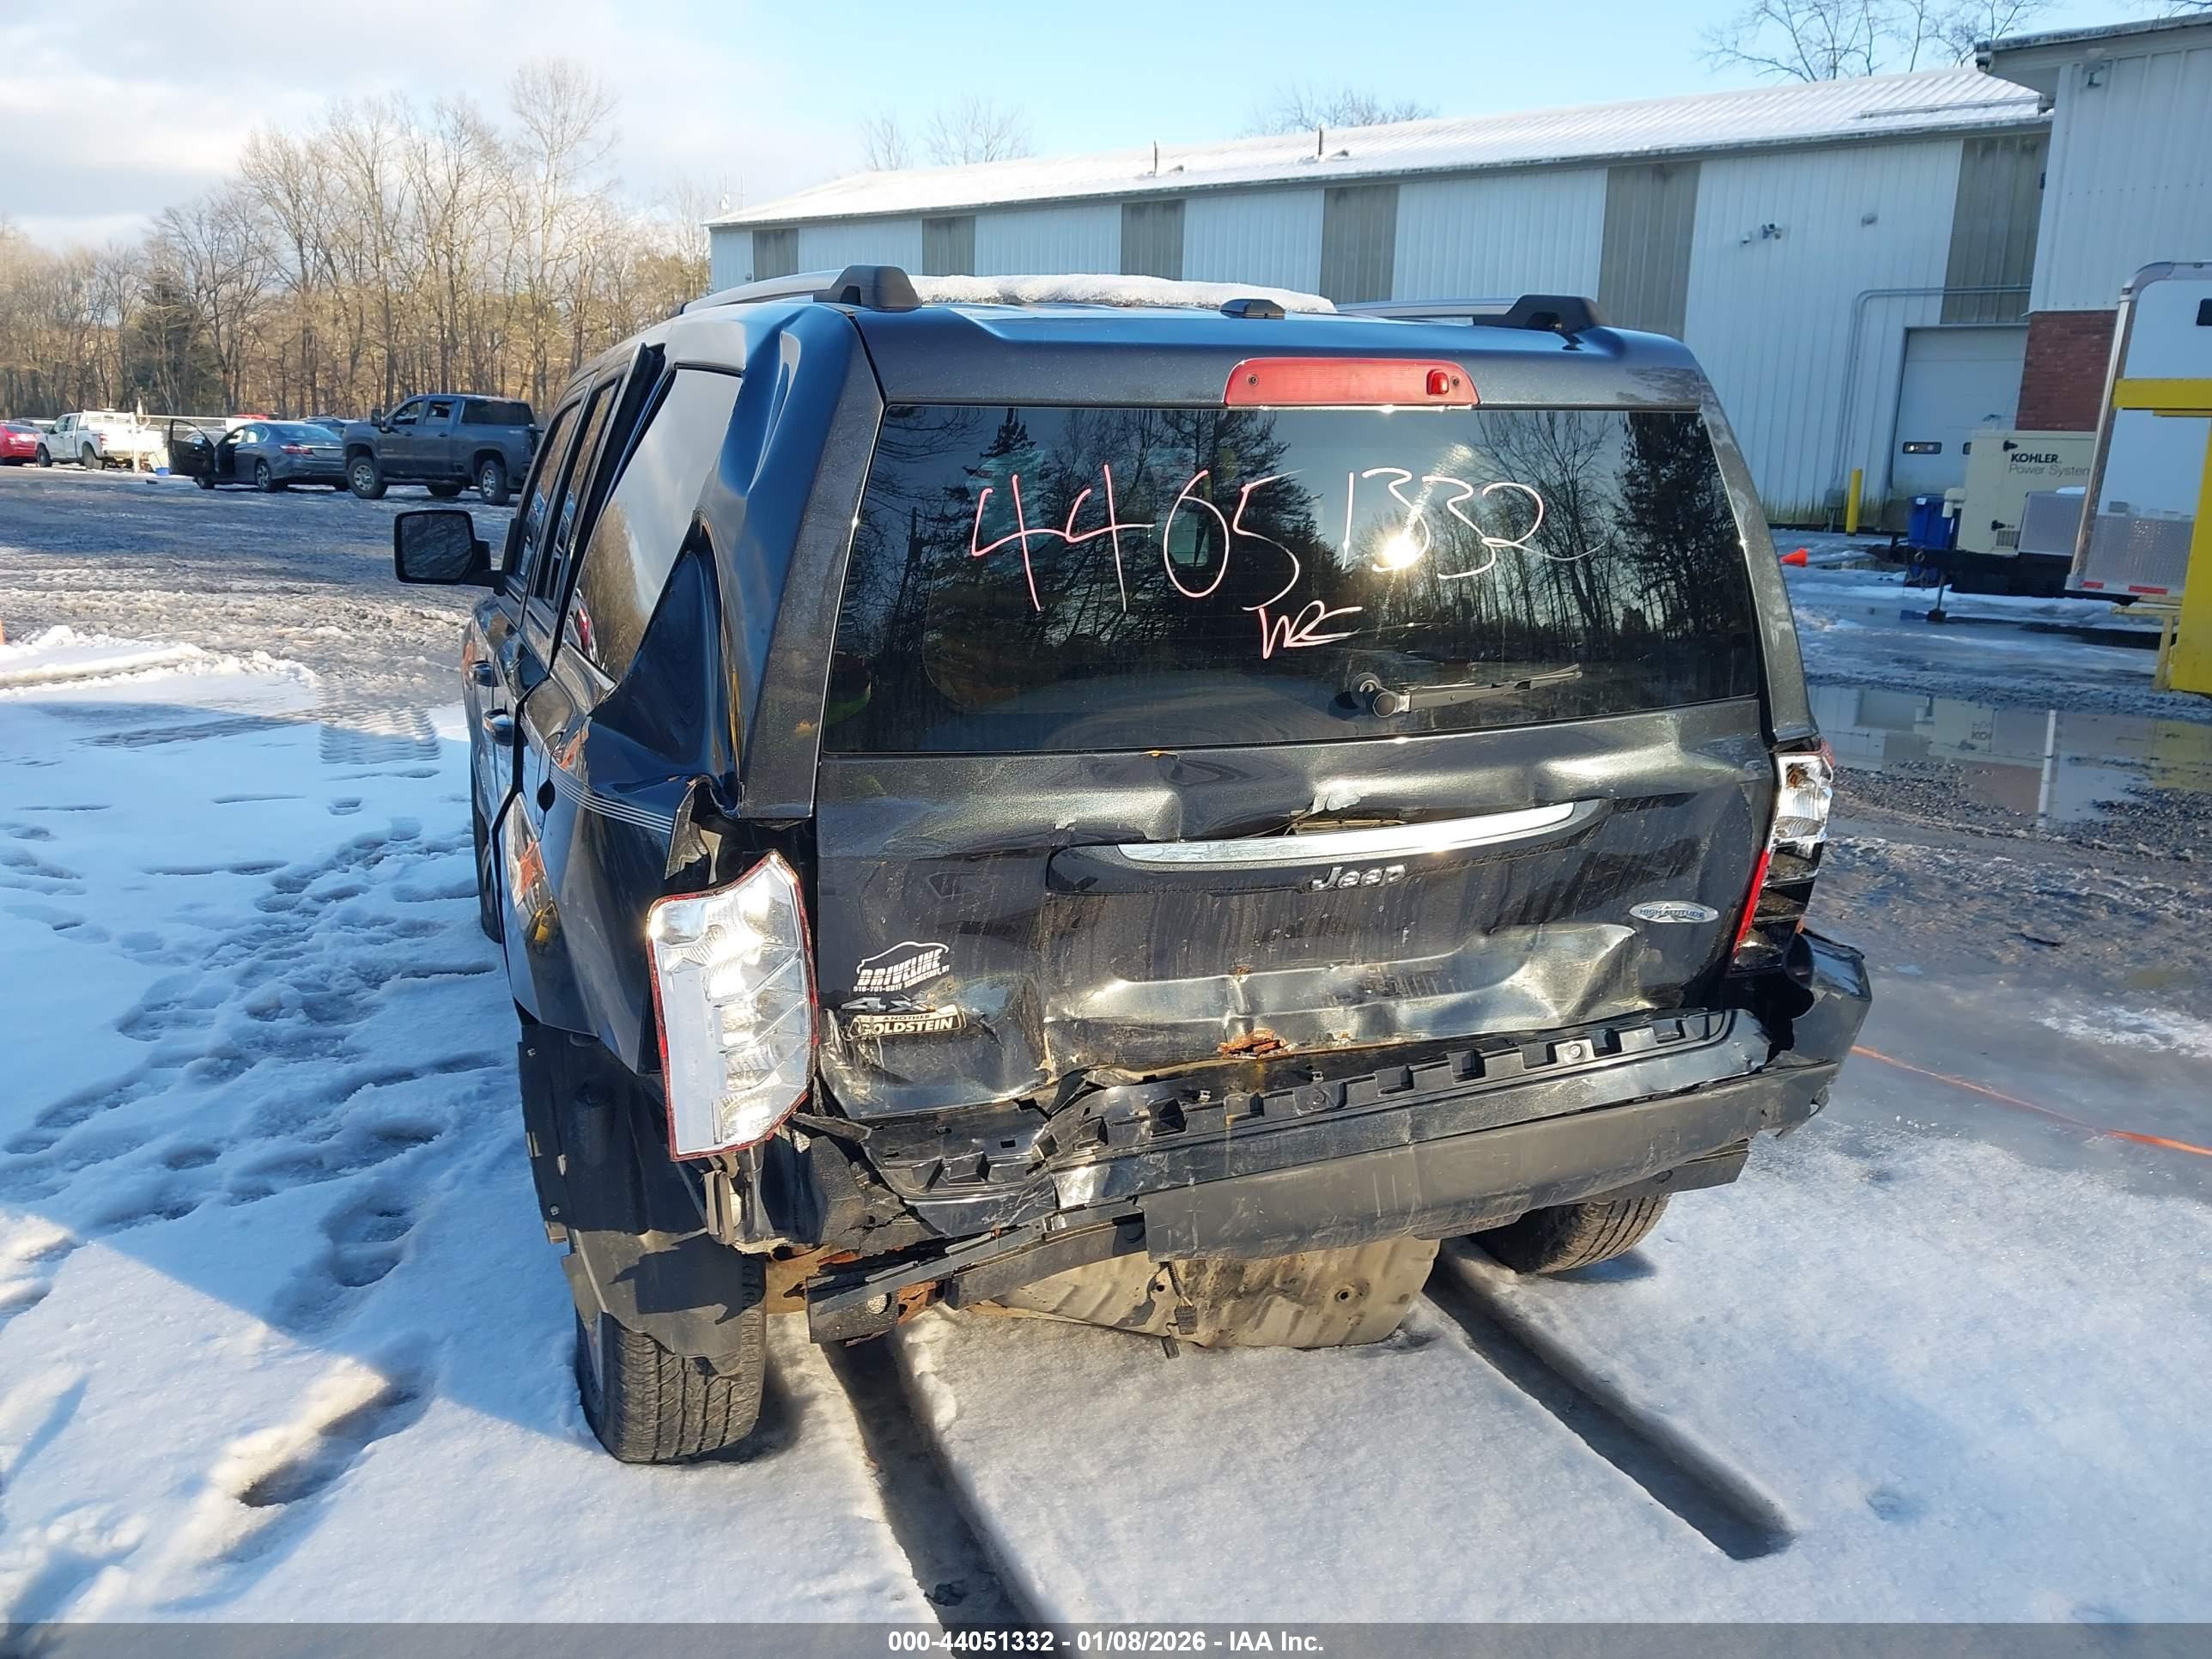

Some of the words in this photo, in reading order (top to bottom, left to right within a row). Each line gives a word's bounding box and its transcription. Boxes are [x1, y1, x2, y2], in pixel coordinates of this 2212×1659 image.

[2010, 453, 2059, 464] KOHLER
[2008, 464, 2046, 475] Power
[1310, 864, 1407, 890] Jeep
[857, 948, 944, 986] DRIVELINE
[860, 1017, 954, 1036] GOLDSTEIN
